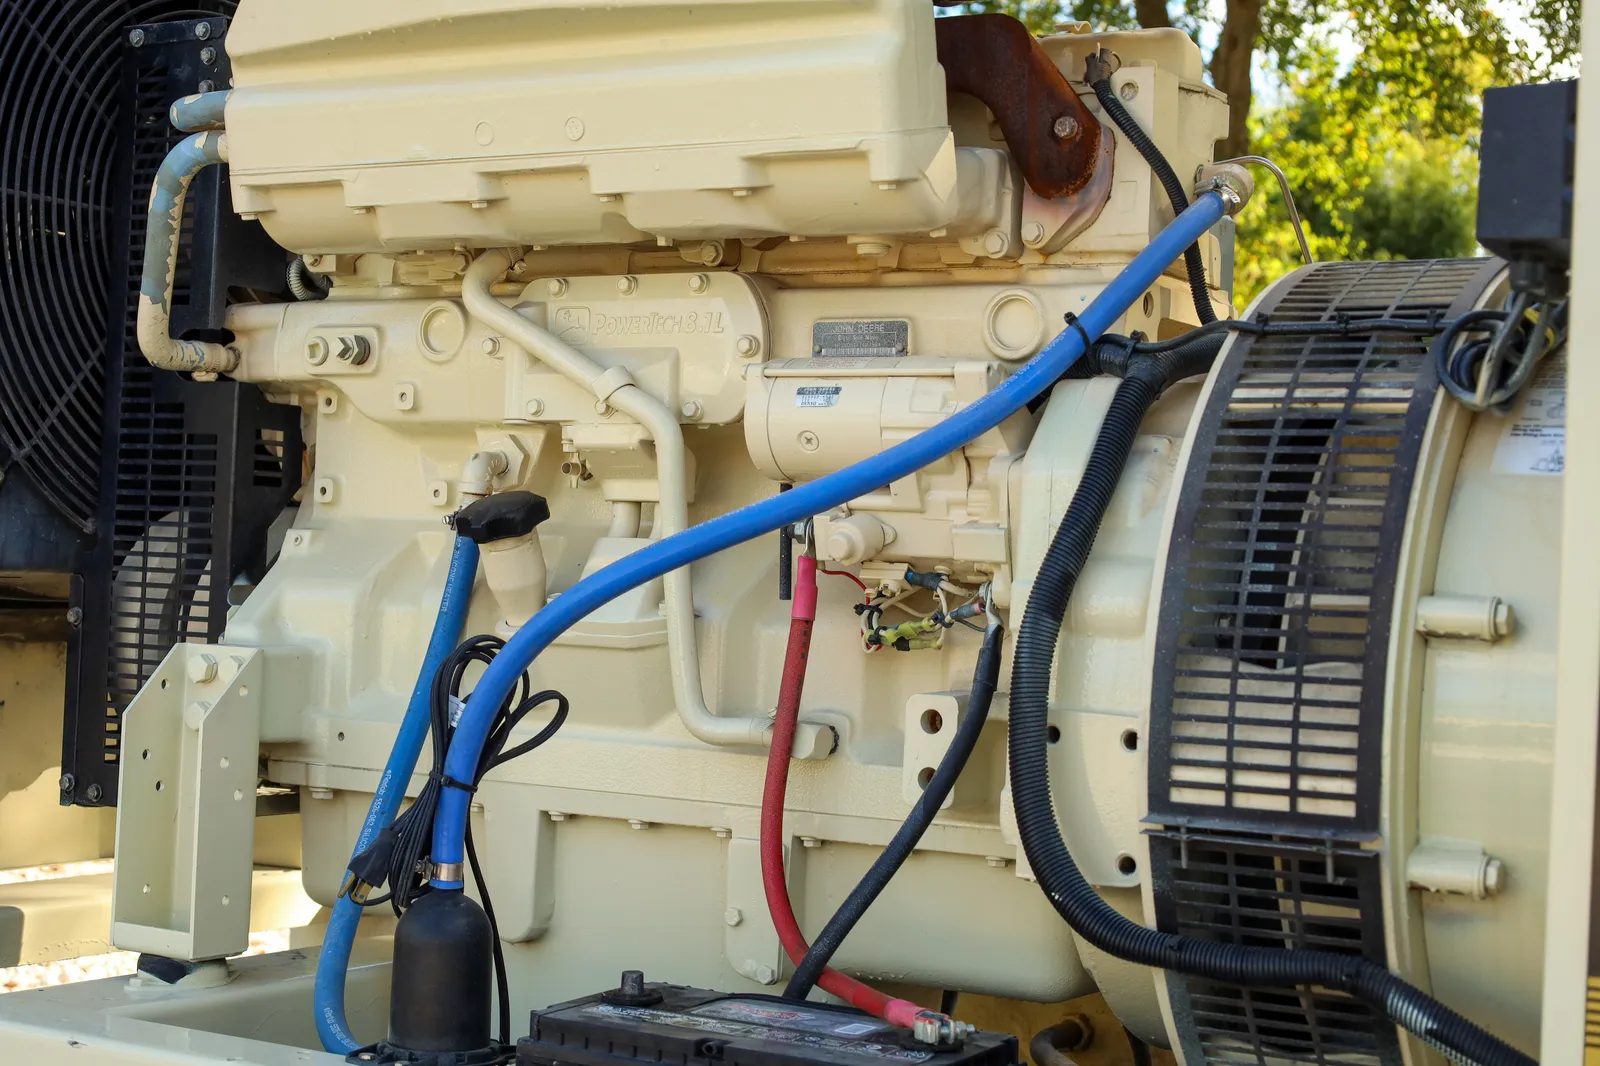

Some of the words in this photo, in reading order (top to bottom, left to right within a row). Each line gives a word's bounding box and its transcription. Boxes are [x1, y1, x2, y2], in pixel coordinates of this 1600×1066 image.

[832, 325, 854, 333] JOHN
[858, 323, 885, 332] DEERE
[441, 583, 452, 612] HEATER
